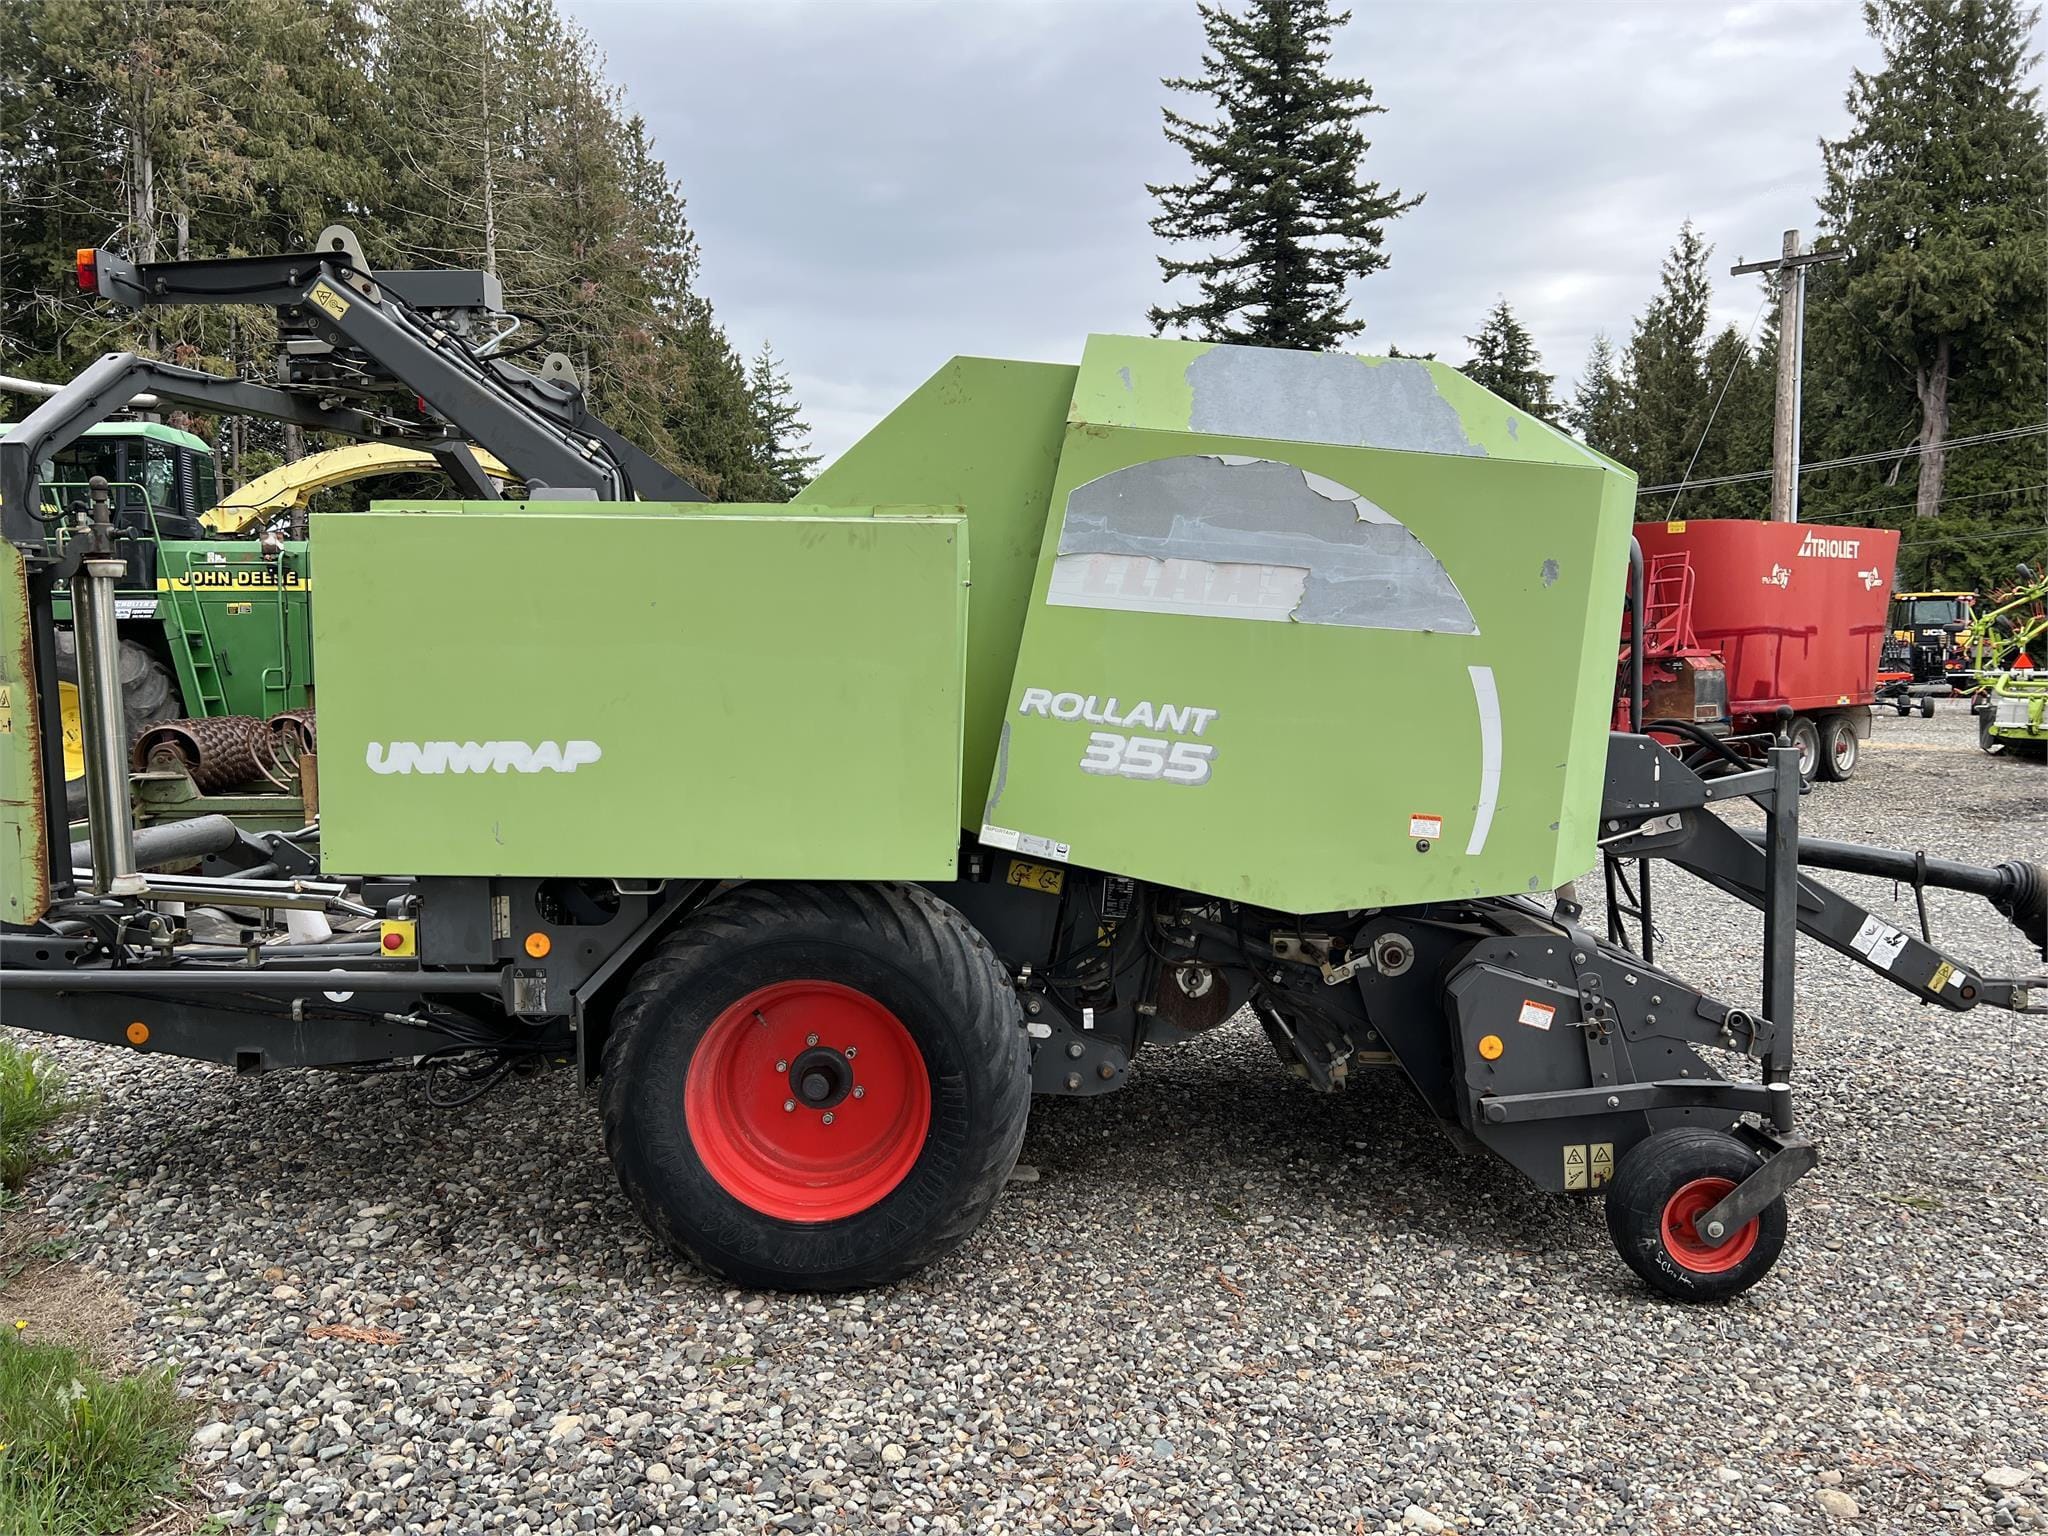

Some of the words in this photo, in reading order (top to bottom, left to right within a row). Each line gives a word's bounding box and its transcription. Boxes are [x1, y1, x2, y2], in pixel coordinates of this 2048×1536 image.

[1810, 538, 1860, 559] TRIOLIET
[179, 571, 232, 585] JOHN
[1018, 687, 1219, 736] ROLLANT
[366, 741, 602, 774] UNIWRAP
[1079, 731, 1216, 785] 355
